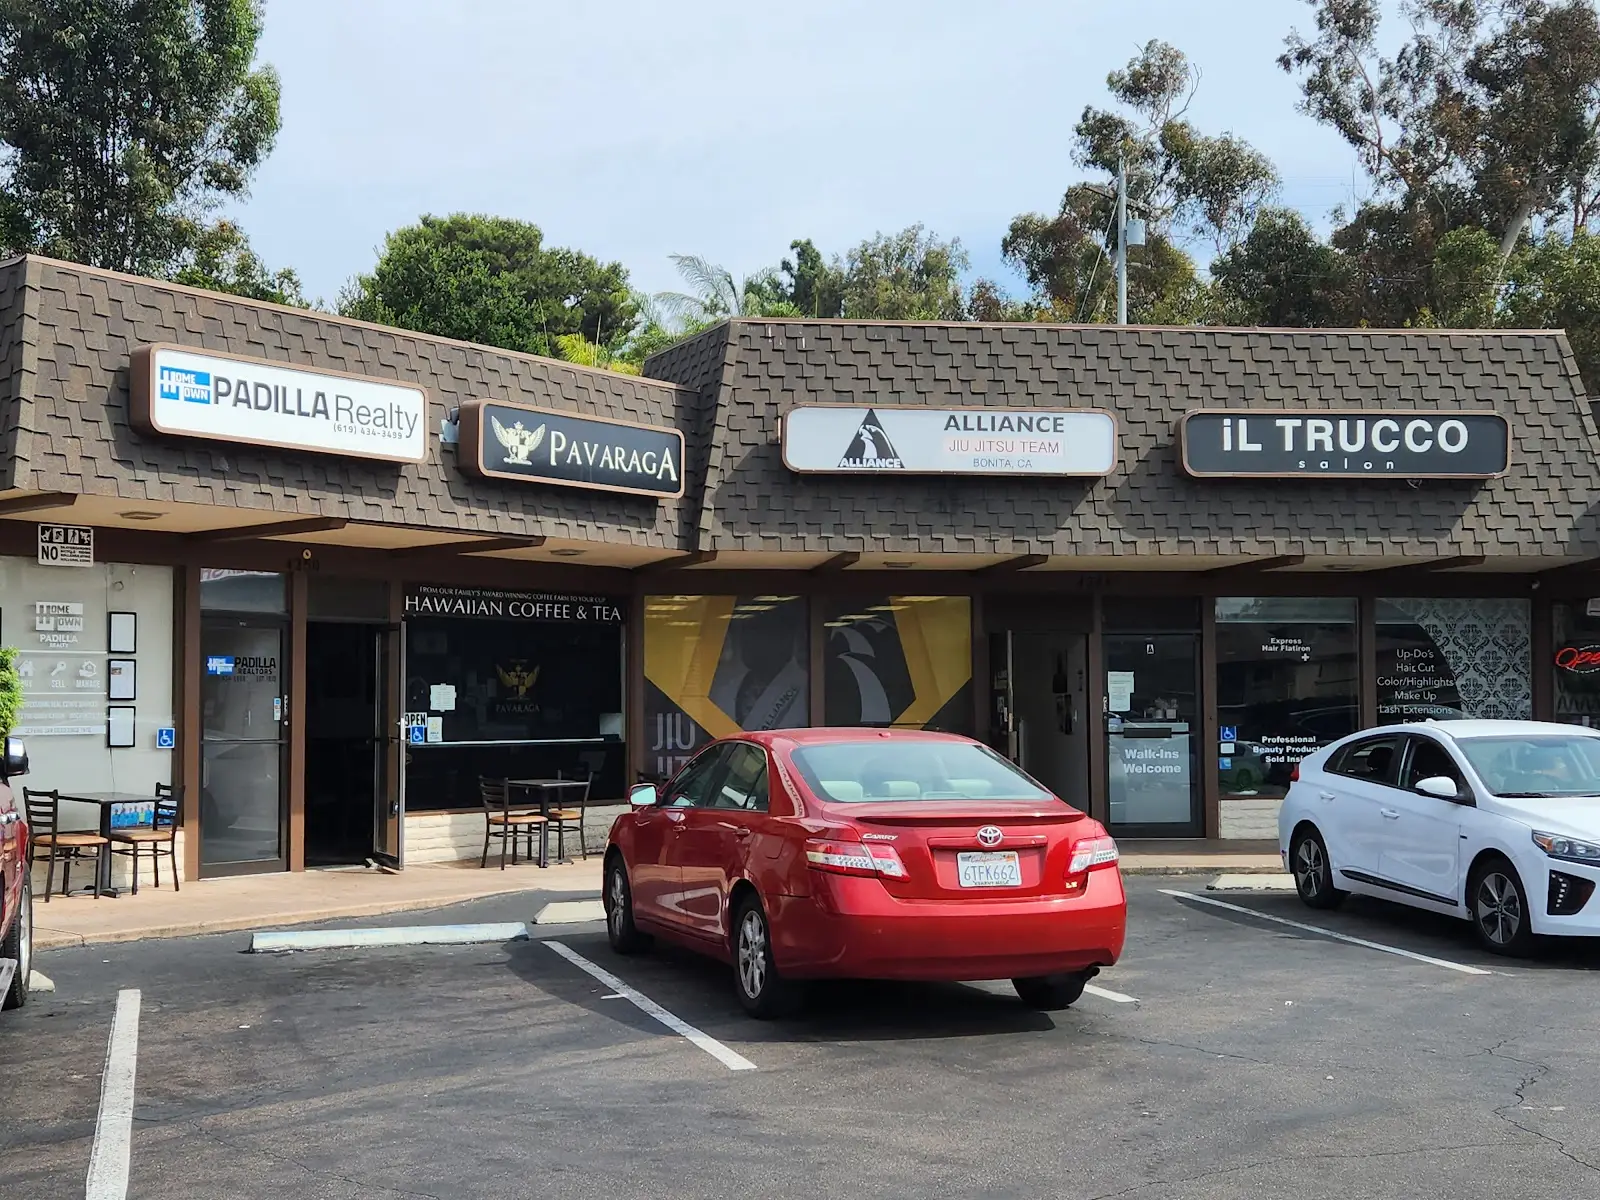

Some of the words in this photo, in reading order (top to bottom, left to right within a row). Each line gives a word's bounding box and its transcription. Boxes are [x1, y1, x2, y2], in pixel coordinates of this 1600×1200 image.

[213, 376, 330, 421] PADILLA
[335, 395, 419, 439] Realty
[943, 414, 1065, 433] ALLIANCE
[332, 422, 358, 436] (619)
[360, 426, 403, 441] 434-3499
[1276, 419, 1469, 453] TRUCCO
[949, 440, 969, 453] JIU
[974, 441, 1015, 453] JITSU
[1020, 441, 1060, 454] TEAM
[550, 431, 678, 482] PAVARAGA
[839, 457, 902, 469] ALLIANCE
[973, 458, 1014, 470] BONITA,
[1017, 459, 1033, 469] CA
[1299, 457, 1395, 470] salon
[41, 545, 58, 561] NO
[419, 586, 438, 594] FROM
[438, 587, 454, 595] OUR
[482, 590, 504, 598] AWARD
[504, 591, 532, 600] WINNING
[533, 593, 553, 601] COFFEE
[405, 595, 503, 616] HAWAIIAN
[508, 601, 571, 619] COFFEE
[576, 606, 587, 620] &
[592, 605, 622, 621] TEA
[39, 633, 78, 644] PADILLA
[1270, 637, 1302, 646] Express
[1396, 648, 1434, 660] Up-Do's
[234, 657, 276, 669] PADILLA
[1396, 663, 1416, 673] Hair
[1417, 663, 1435, 673] Cut
[1376, 677, 1455, 688] Color/Highlights
[1395, 691, 1421, 700] Make
[1423, 691, 1437, 702] Up
[1379, 704, 1401, 714] Lash
[1403, 704, 1453, 715] Extensions
[404, 713, 426, 727] OPEN
[652, 712, 696, 751] JIU
[1262, 735, 1316, 744] Professional
[1125, 748, 1180, 760] Walk-Ins
[1253, 745, 1283, 755] Beauty
[1265, 755, 1285, 763] Sold
[1123, 763, 1181, 774] Welcome
[964, 864, 1016, 881] 6TFK662
